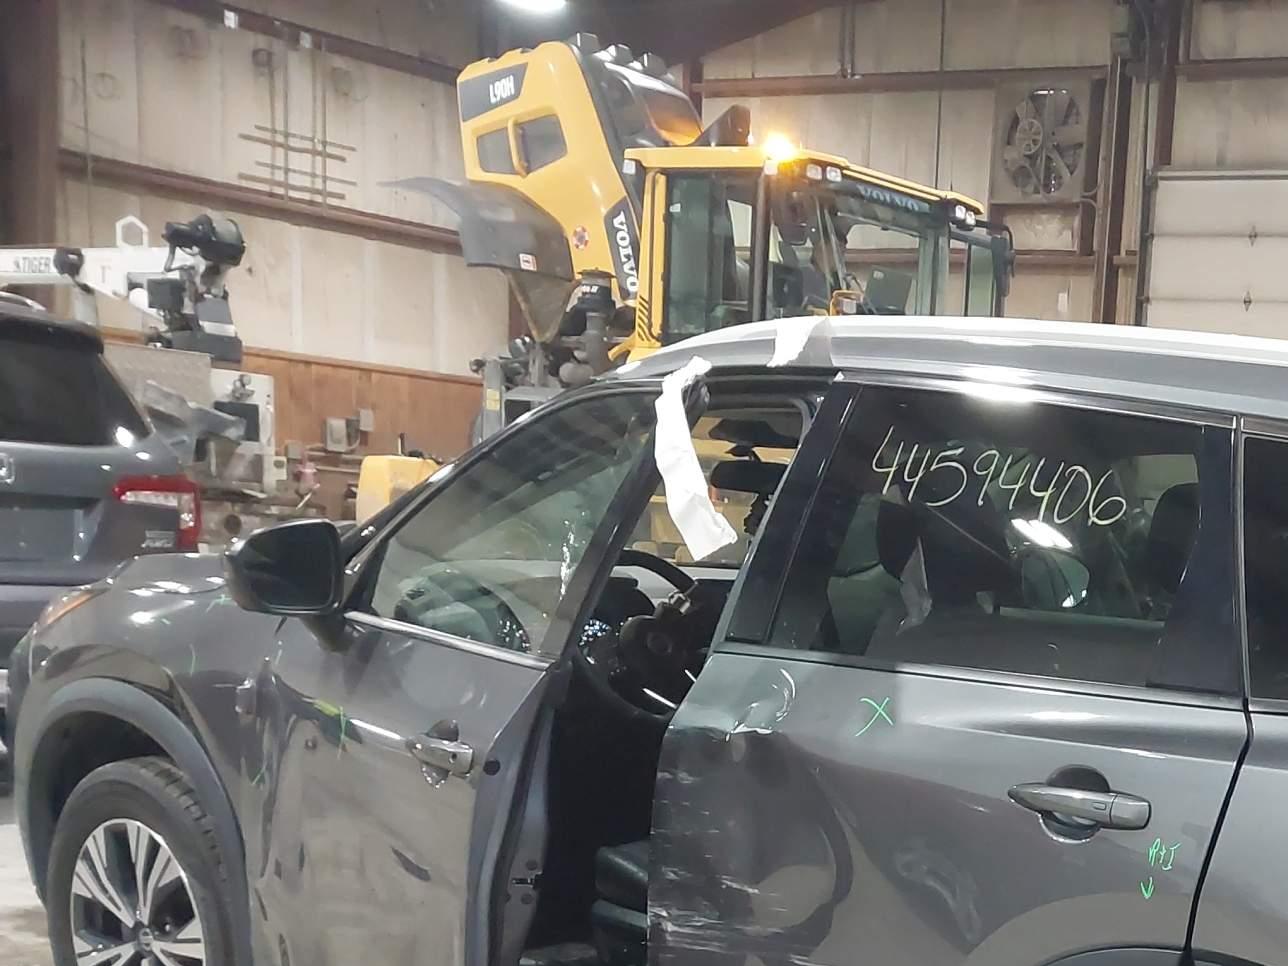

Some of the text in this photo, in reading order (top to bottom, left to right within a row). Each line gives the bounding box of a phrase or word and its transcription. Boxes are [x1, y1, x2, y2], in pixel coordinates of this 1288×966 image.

[489, 75, 515, 104] L90H
[613, 210, 640, 292] VOLVO
[872, 425, 1127, 526] 44594406
